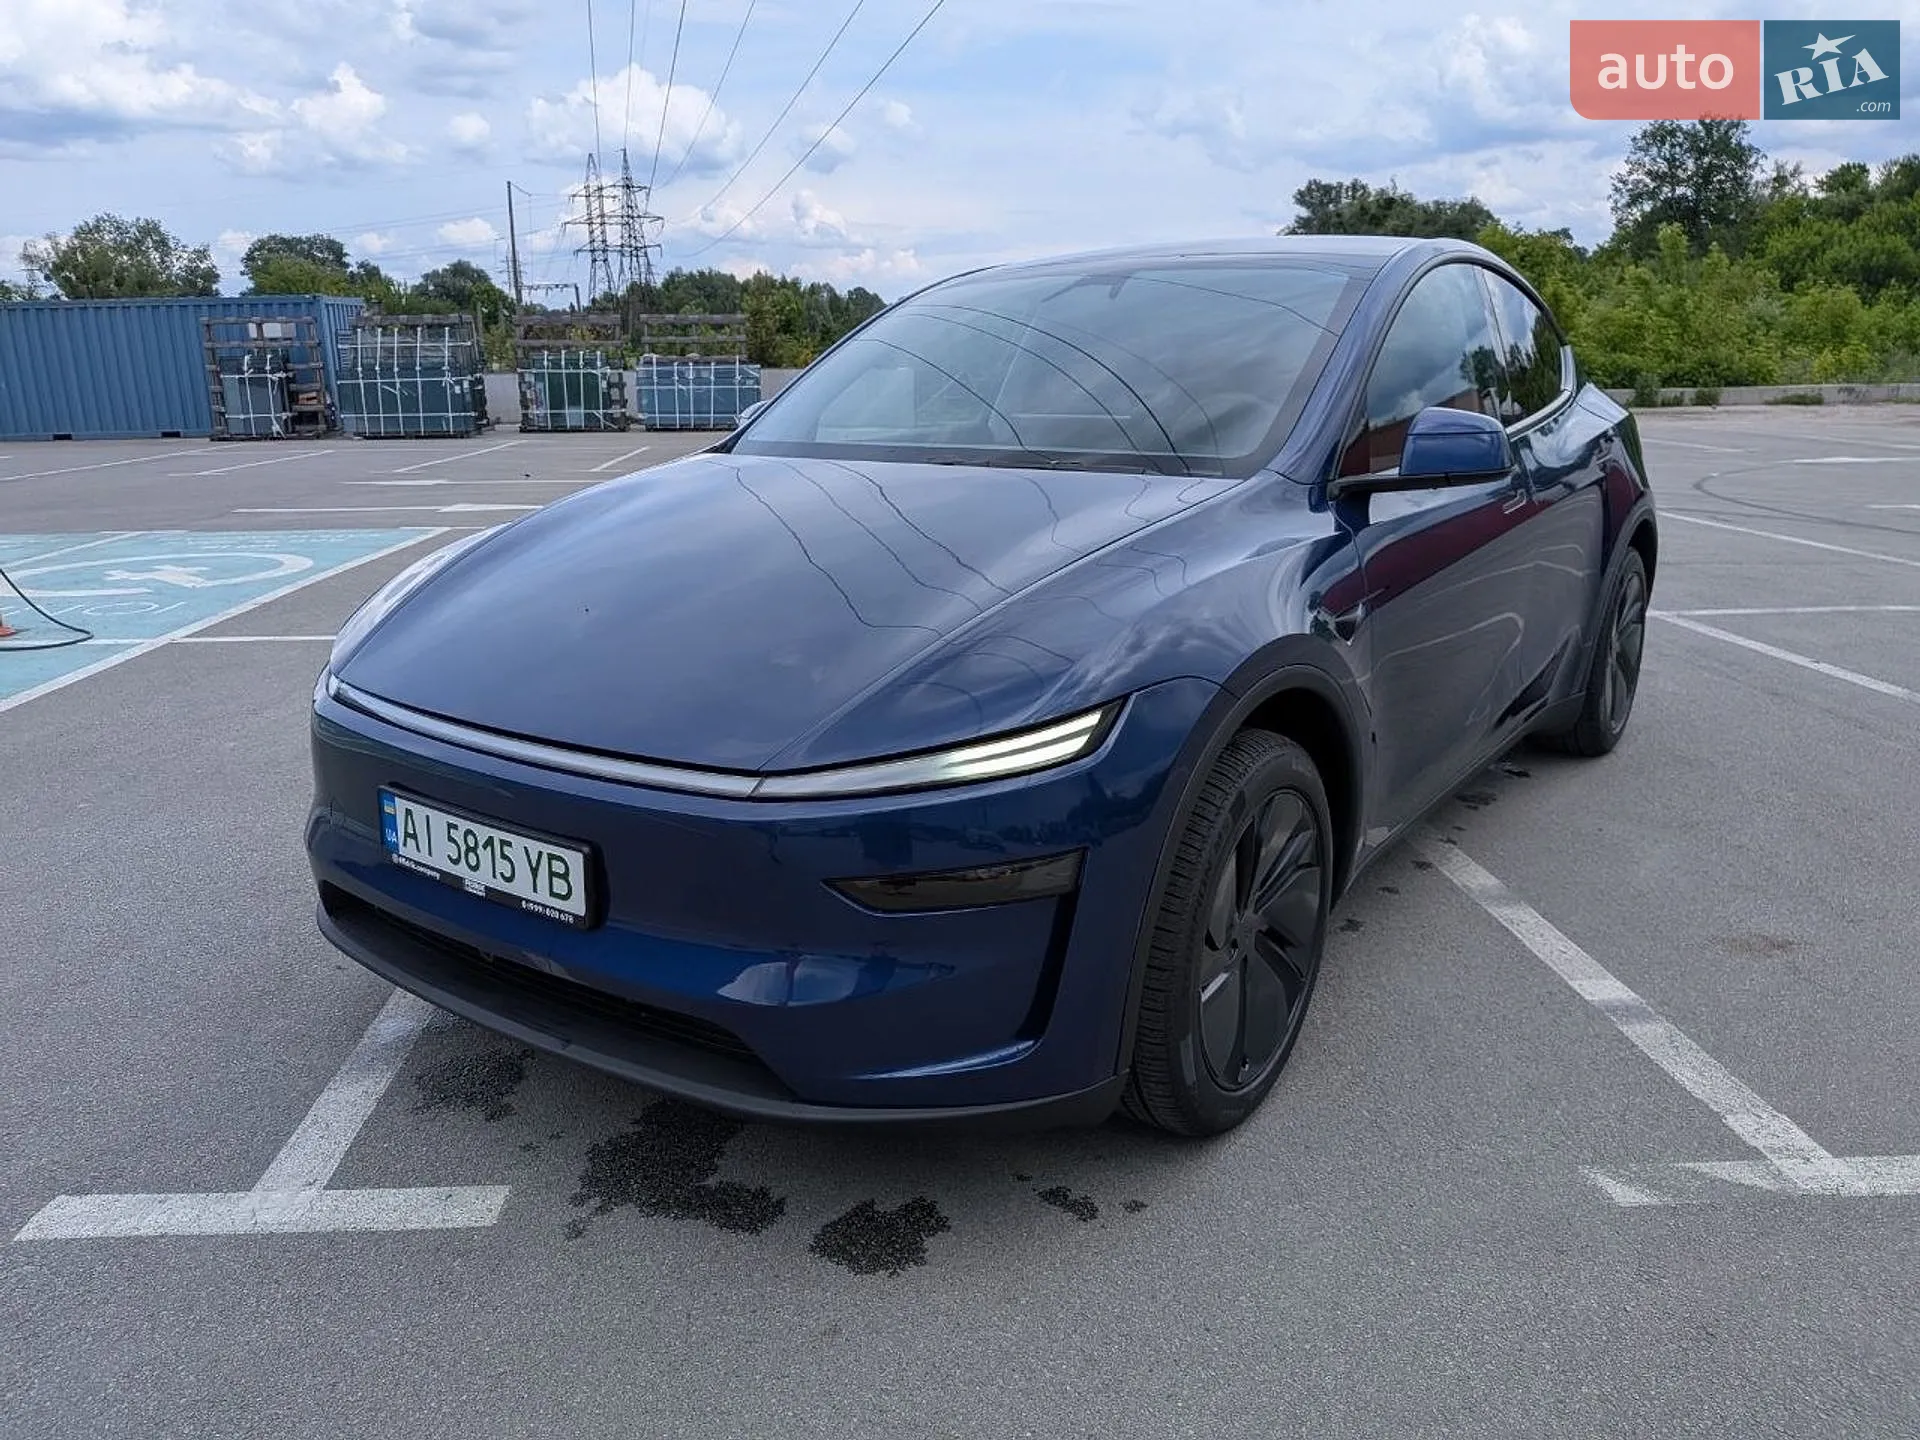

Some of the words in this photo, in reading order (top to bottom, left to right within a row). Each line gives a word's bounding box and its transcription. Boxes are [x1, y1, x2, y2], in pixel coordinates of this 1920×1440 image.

[385, 828, 398, 843] UA
[403, 807, 433, 858] AI
[446, 820, 516, 884] 5815
[523, 845, 573, 901] YB
